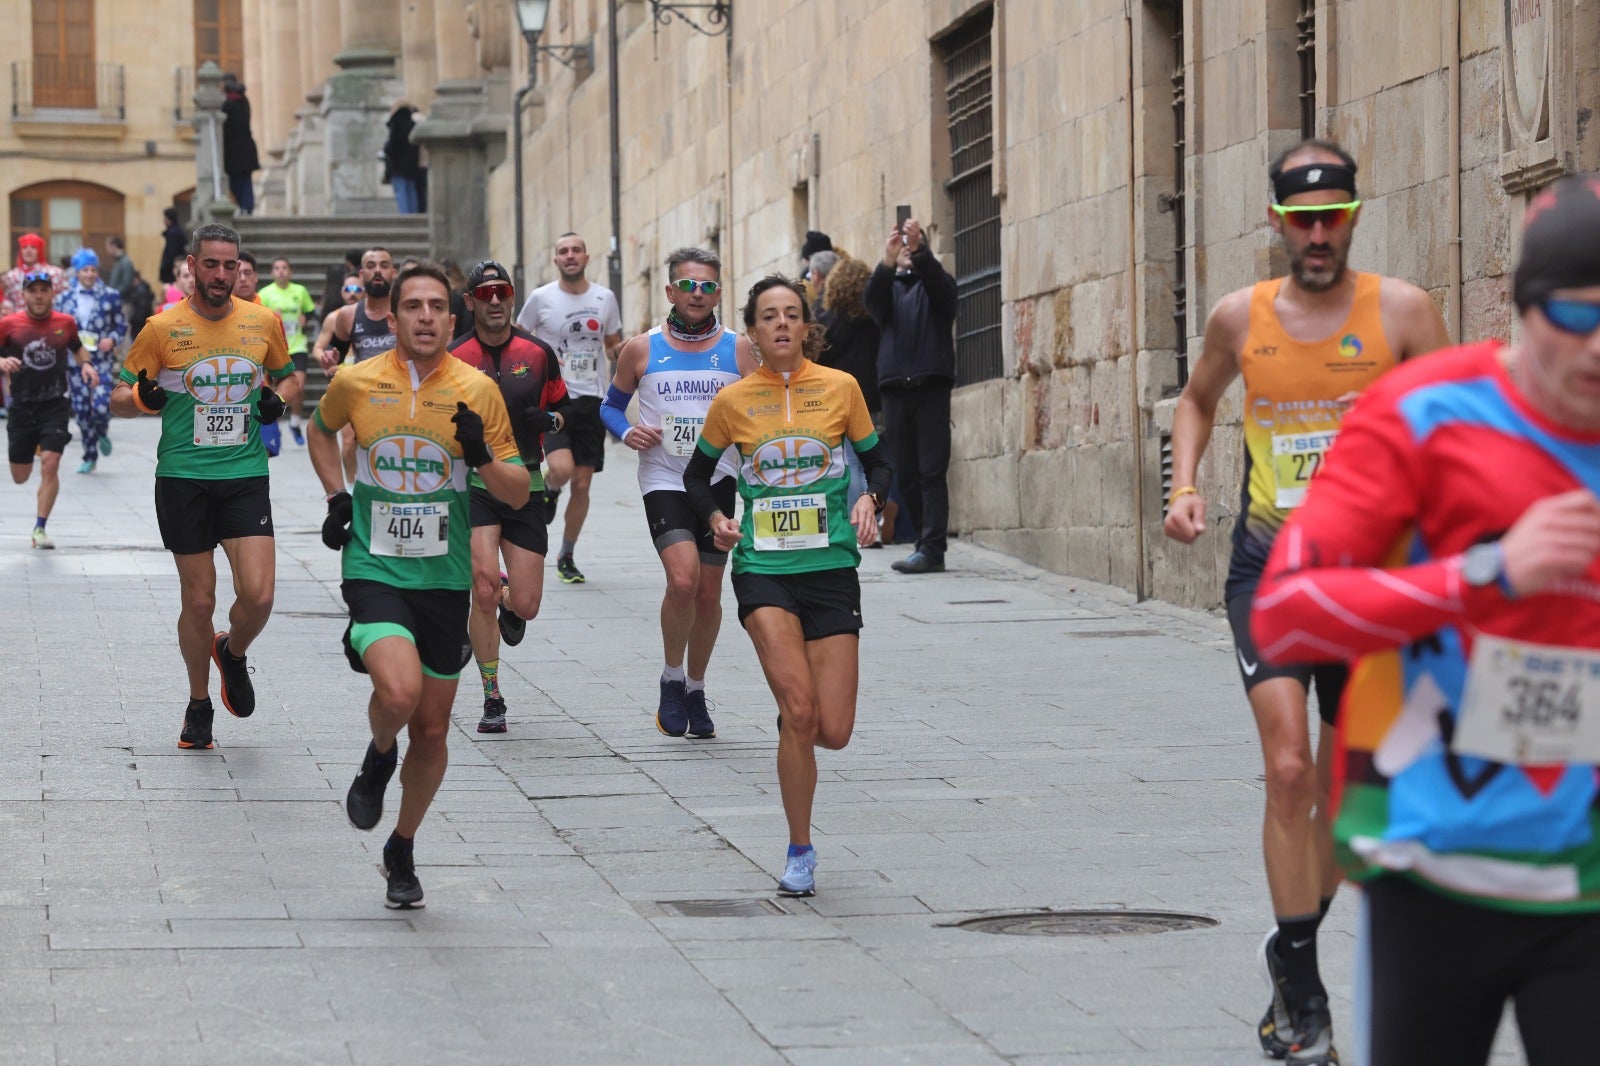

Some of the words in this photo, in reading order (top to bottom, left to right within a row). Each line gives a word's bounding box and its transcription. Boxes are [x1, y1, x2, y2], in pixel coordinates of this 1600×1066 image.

[570, 360, 588, 372] 648
[191, 372, 253, 388] ALCER
[657, 381, 672, 395] LA
[675, 378, 725, 394] ARMUÑA
[210, 406, 246, 414] SETEL
[1277, 400, 1315, 412] ESTER
[206, 415, 234, 432] 323
[674, 416, 706, 425] SETE
[673, 425, 695, 442] 241
[1295, 435, 1333, 450] SET
[375, 455, 445, 477] ALCER
[759, 455, 824, 471] ALCER
[1293, 452, 1321, 481] 22
[391, 506, 441, 516] SETEL
[771, 498, 819, 509] SETEL
[387, 517, 424, 538] 404
[772, 510, 800, 532] 120
[1502, 677, 1583, 728] 364
